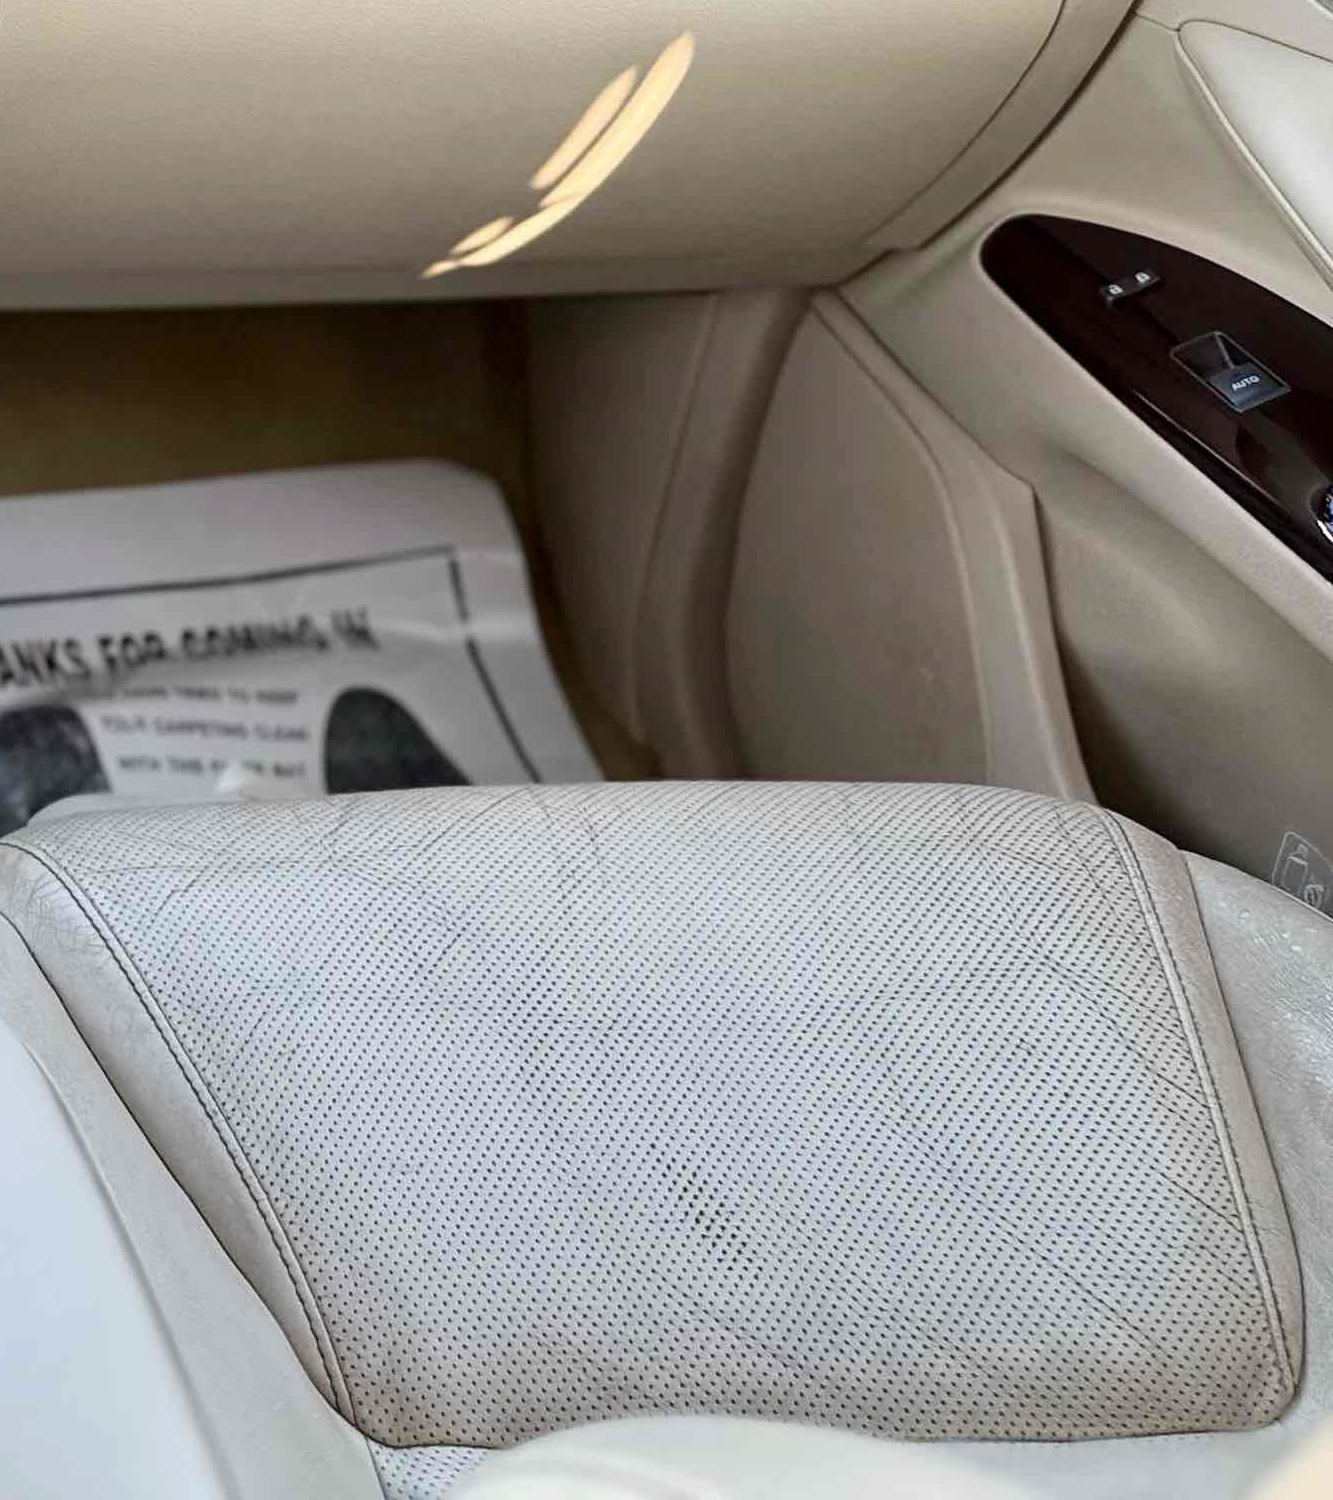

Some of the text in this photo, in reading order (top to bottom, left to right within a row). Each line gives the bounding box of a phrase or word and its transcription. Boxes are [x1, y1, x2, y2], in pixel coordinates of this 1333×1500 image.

[1230, 375, 1261, 392] AUTO
[96, 632, 168, 673] FOR
[179, 614, 329, 661] COMING
